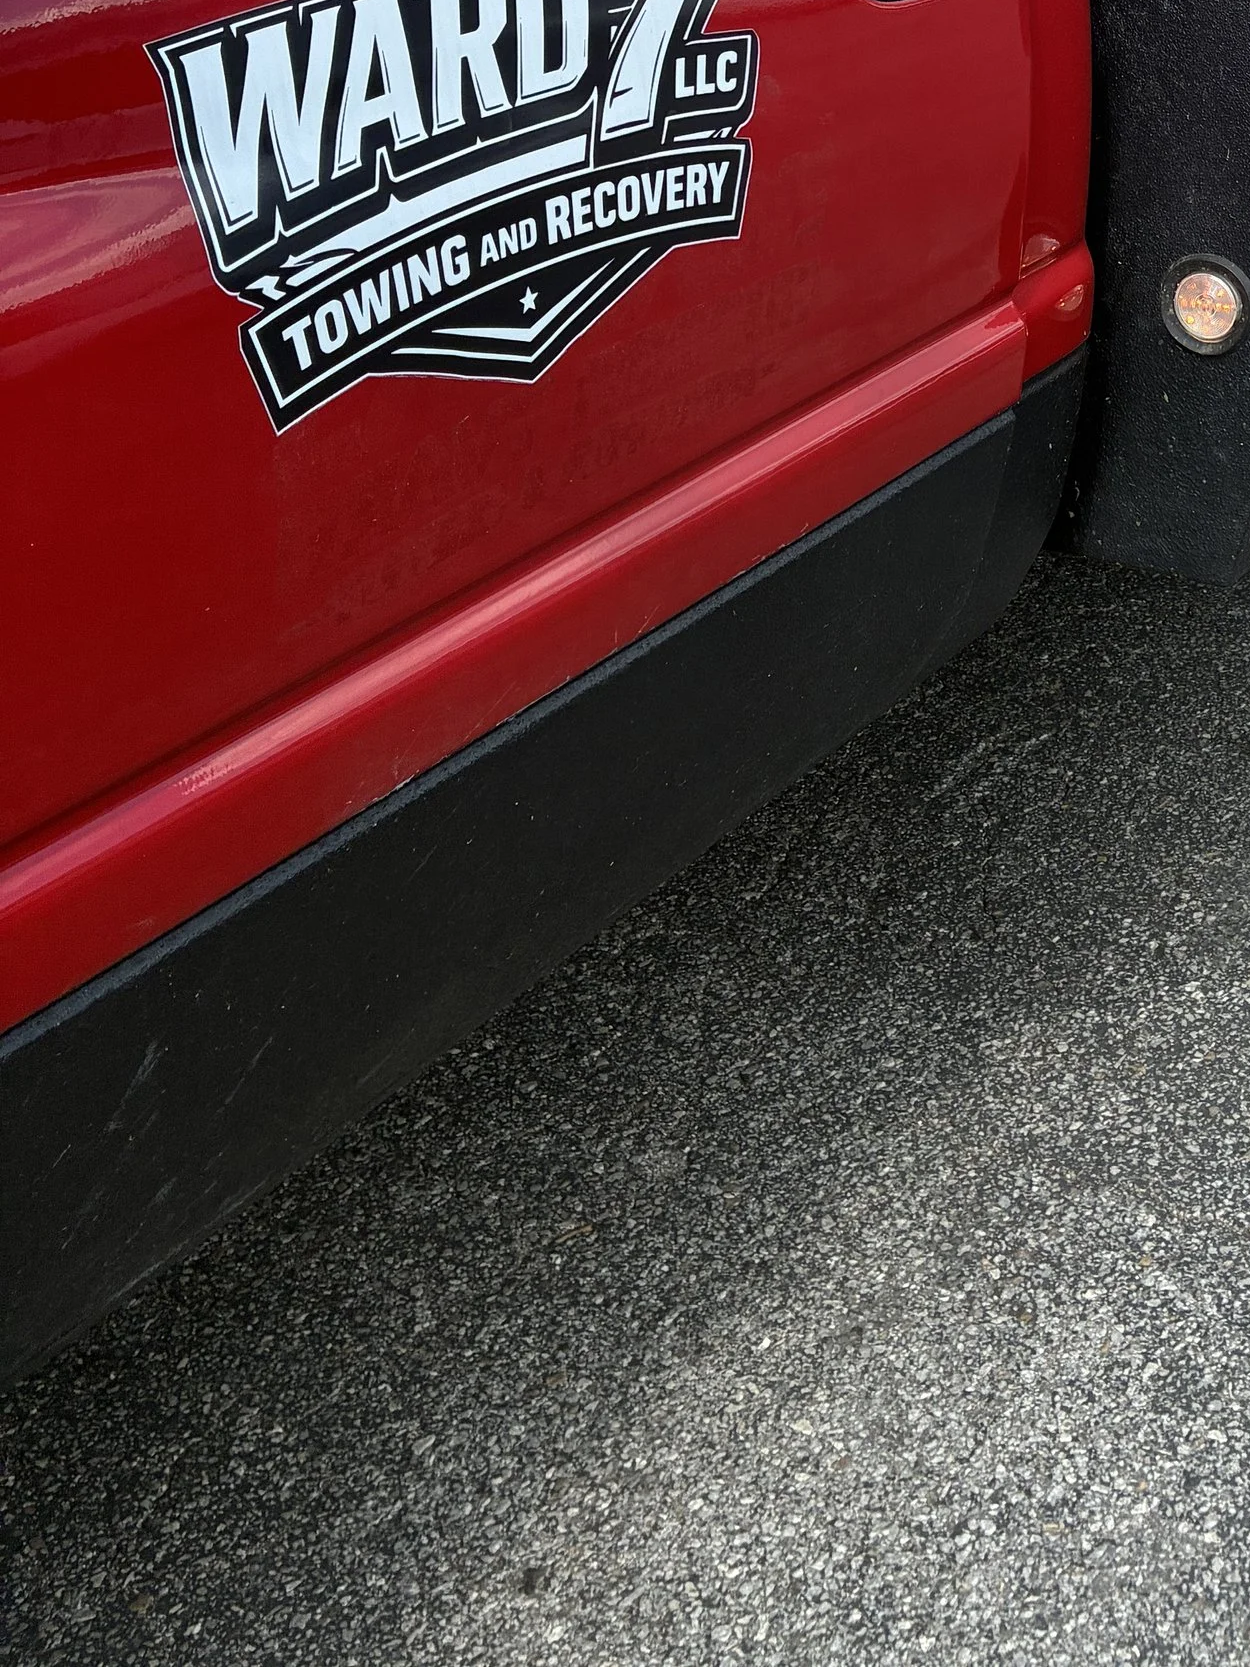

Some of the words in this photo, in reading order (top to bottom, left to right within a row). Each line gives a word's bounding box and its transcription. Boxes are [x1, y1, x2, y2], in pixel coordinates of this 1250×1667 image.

[675, 50, 738, 99] LLC
[282, 235, 467, 371] TOWING
[479, 216, 538, 268] AND
[545, 160, 731, 245] RECOVERY
